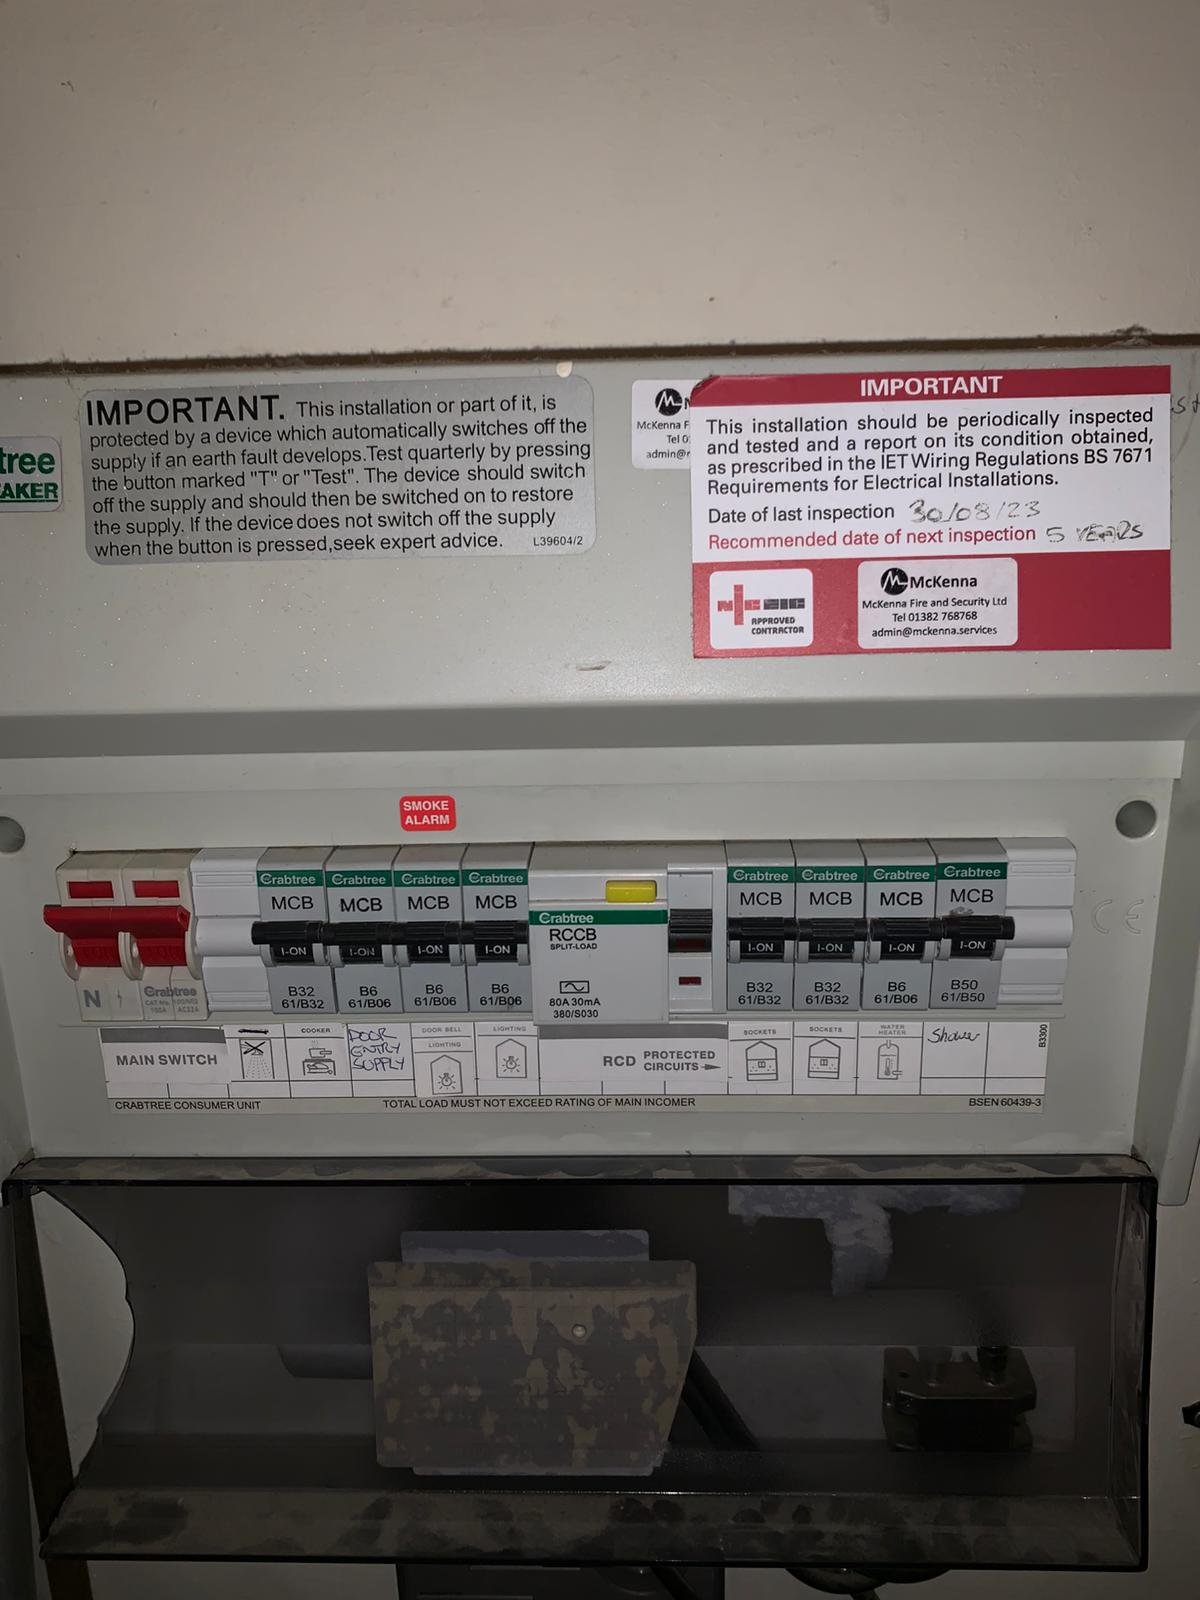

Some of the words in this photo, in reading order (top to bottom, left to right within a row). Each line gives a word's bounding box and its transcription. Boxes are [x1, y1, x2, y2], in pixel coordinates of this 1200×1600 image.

[861, 375, 1002, 397] IMPORTANT
[87, 395, 284, 425] IMPORTANT.
[296, 401, 334, 417] This
[340, 399, 431, 416] installation
[437, 401, 454, 413] or
[460, 397, 495, 416] part
[500, 396, 517, 410] of
[522, 396, 536, 412] it,
[542, 394, 556, 410] is
[637, 421, 680, 429] McKenna
[706, 419, 743, 434] This
[752, 417, 847, 433] installation
[858, 414, 917, 430] should
[927, 414, 948, 428] be
[958, 409, 1060, 431] periodically
[1069, 407, 1152, 425] inspected
[90, 430, 168, 450] protected
[175, 430, 194, 448] by
[201, 432, 210, 444] a
[215, 428, 272, 443] device
[277, 425, 326, 441] which
[332, 422, 447, 440] automatically
[452, 420, 528, 437] switches
[534, 418, 556, 434] off
[560, 418, 587, 433] the
[667, 435, 679, 443] Tel
[708, 479, 828, 497] Requirements
[834, 476, 858, 490] for
[864, 474, 942, 490] Electrical
[949, 471, 1058, 488] Installations.
[709, 508, 746, 523] Date
[752, 507, 768, 522] of
[774, 507, 802, 521] last
[808, 503, 894, 522] inspection
[533, 536, 583, 546] L39604/2
[709, 531, 836, 549] Recommended
[842, 531, 878, 546] date
[884, 529, 902, 544] of
[907, 528, 942, 543] next
[949, 526, 1035, 544] inspection
[95, 542, 141, 557] when
[147, 541, 173, 555] the
[179, 539, 232, 554] button
[238, 538, 251, 552] is
[380, 534, 436, 552] expert
[441, 532, 502, 547] advice.
[910, 576, 977, 588] McKenna
[862, 600, 906, 609] McKenna
[910, 599, 928, 608] Fire
[930, 598, 949, 607] and
[951, 598, 990, 608] Security
[993, 597, 1007, 606] Ltd
[893, 613, 906, 621] Tel
[908, 612, 938, 621] 01382
[942, 611, 977, 620] 768768
[872, 625, 997, 638] admin@mckenna.services
[403, 800, 449, 811] SMOKE
[405, 815, 449, 824] ALARM
[733, 870, 788, 880] Crabtree
[802, 869, 857, 880] Crabtree
[873, 869, 930, 880] Crabtree
[944, 866, 1001, 877] Crabtree
[261, 874, 316, 884] Crabtree
[332, 874, 386, 885] Crabtree
[402, 874, 455, 885] Crabtree
[469, 872, 523, 883] Crabtree
[740, 892, 782, 905] MCB
[810, 892, 852, 905] MCB
[880, 892, 922, 906] MCB
[951, 889, 993, 902] MCB
[272, 896, 313, 910] MCB
[340, 898, 382, 912] MCB
[408, 896, 449, 909] MCB
[476, 895, 517, 908] MCB
[539, 913, 594, 924] Crabtree
[550, 928, 597, 941] RCCB
[426, 985, 444, 994] B6
[492, 984, 509, 993] B6
[747, 982, 773, 992] B32
[815, 982, 841, 992] B32
[888, 982, 906, 991] B6
[951, 980, 978, 989] B50
[144, 986, 196, 997] Crabtree
[288, 986, 315, 996] B32
[360, 986, 378, 996] B6
[84, 990, 101, 1008] N
[414, 997, 456, 1006] 61/B06
[480, 996, 522, 1005] 61/B06
[738, 995, 781, 1004] 61/B32
[806, 995, 849, 1004] 61/B32
[874, 995, 918, 1004] 61/B06
[941, 992, 985, 1002] 61/B50
[282, 1000, 324, 1008] 61/B32
[348, 999, 391, 1008] 61/B06
[349, 1028, 397, 1041] DOOR
[1039, 1024, 1048, 1047] B3300
[117, 1056, 154, 1065] MAIN
[159, 1055, 217, 1065] SWITCH
[352, 1057, 404, 1071] SUPPLY
[603, 1056, 636, 1066] RCD
[174, 1101, 234, 1109] CONSUMER
[384, 1100, 416, 1109] TOTAL
[555, 1098, 595, 1107] RATING
[645, 1098, 695, 1106] INCOMER
[969, 1098, 999, 1106] BSEN
[1001, 1098, 1041, 1106] 60439-3
